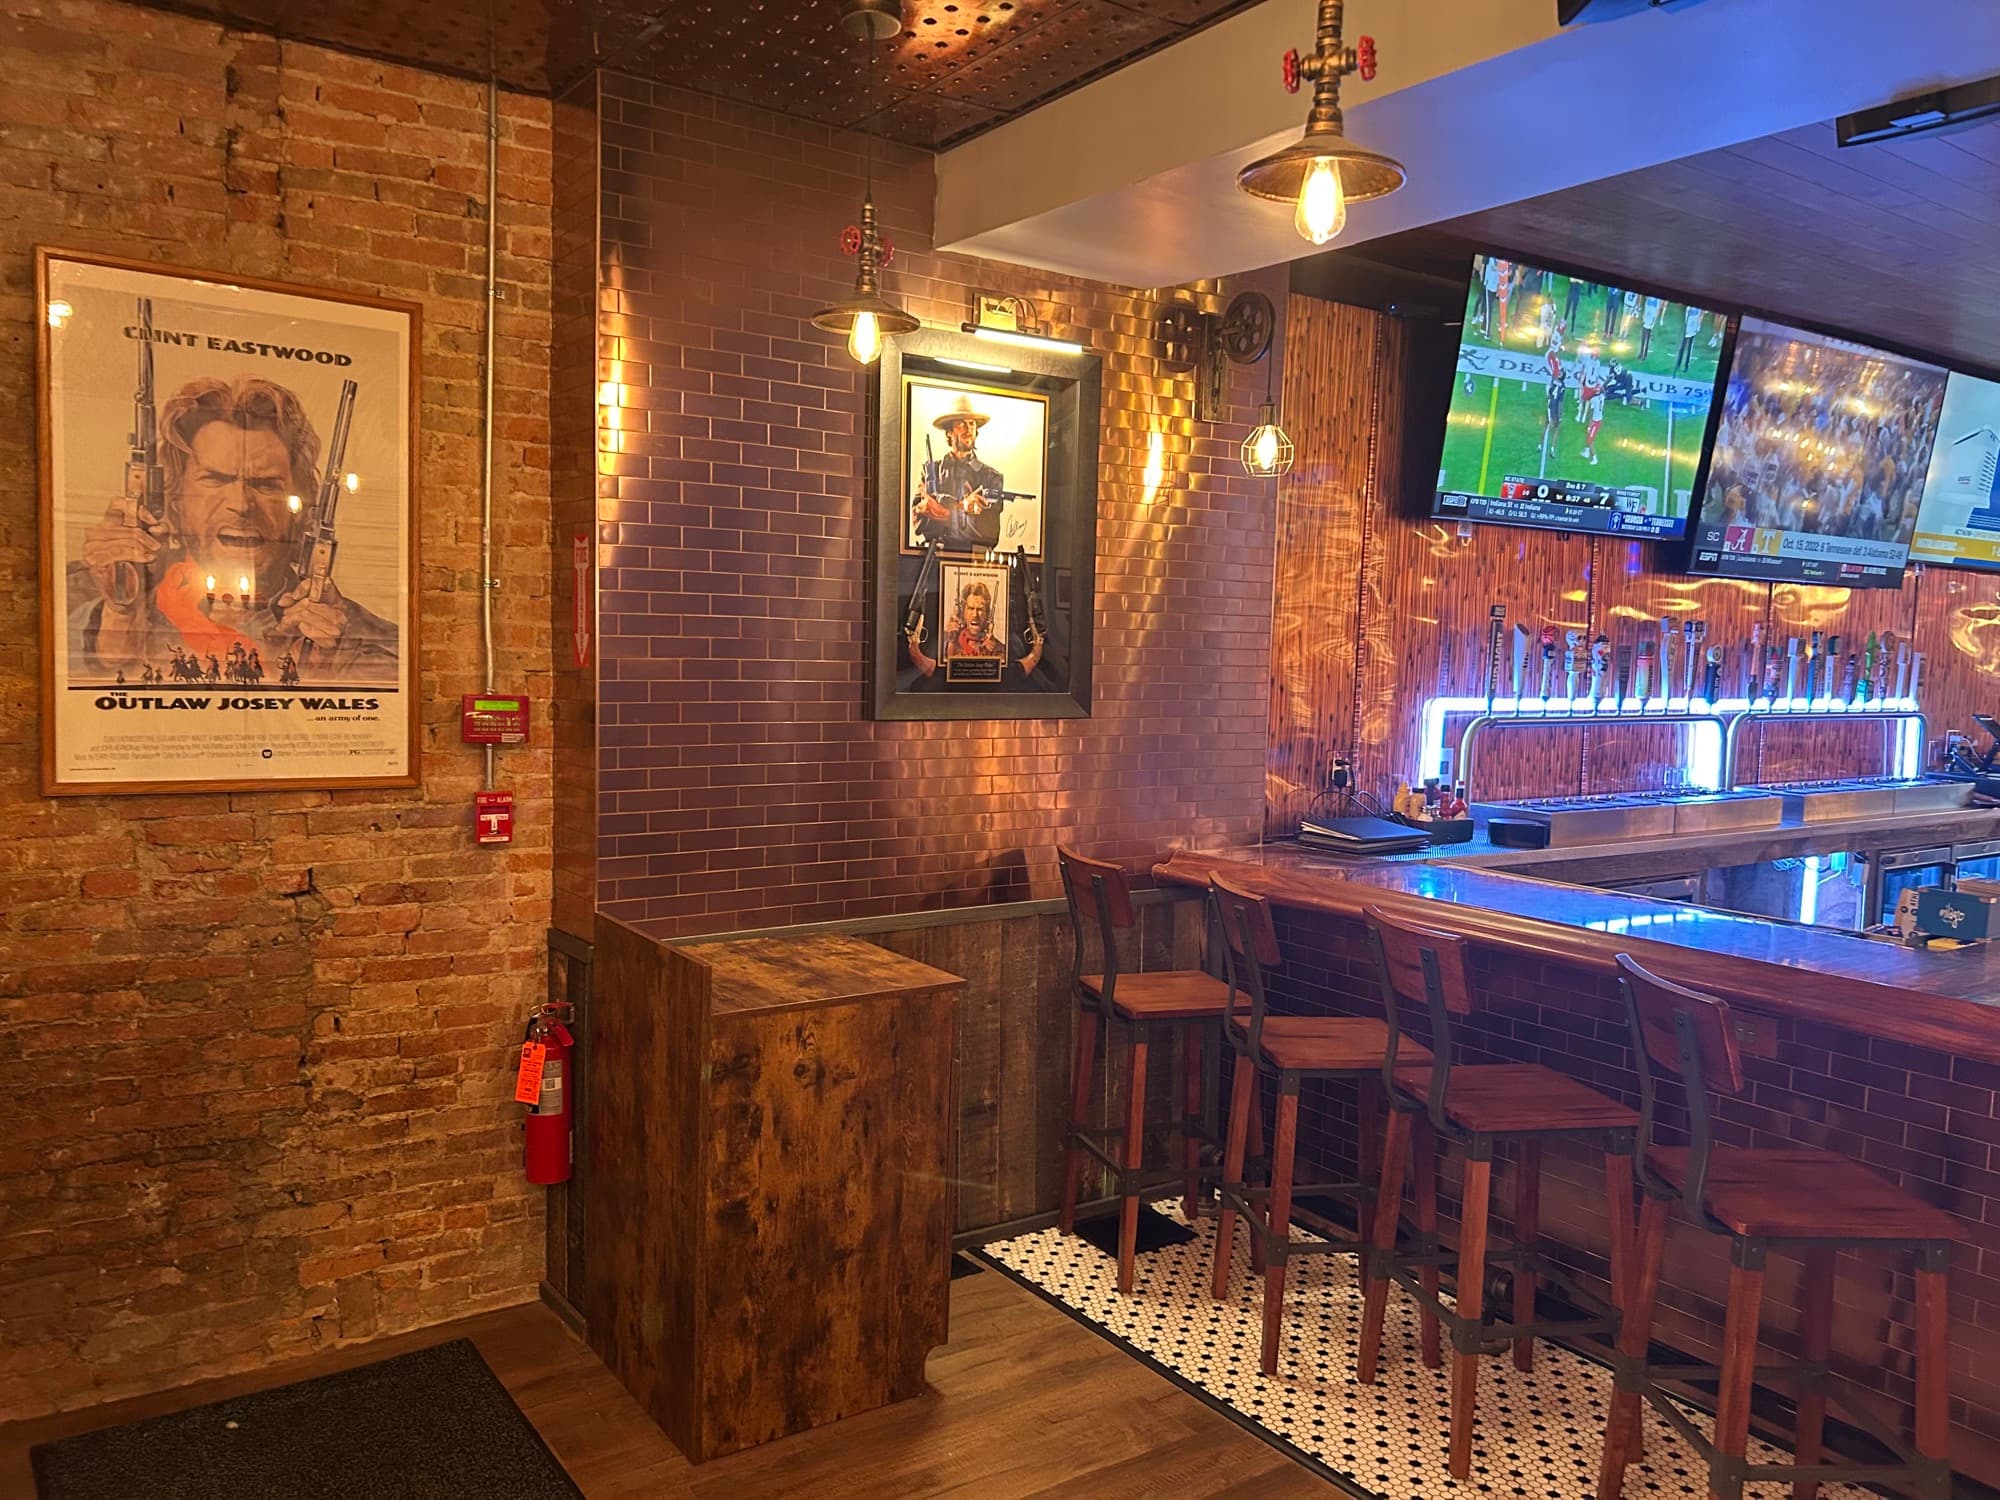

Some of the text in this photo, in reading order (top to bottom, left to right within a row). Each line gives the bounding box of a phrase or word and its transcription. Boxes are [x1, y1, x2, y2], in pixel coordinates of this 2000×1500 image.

[123, 325, 353, 368] CLINT EASTWOOD
[1537, 484, 1549, 498] 0
[1599, 492, 1610, 505] 7
[1706, 531, 1720, 542] SC
[1699, 551, 1718, 562] ESPN
[1825, 542, 1853, 555] Tennessee
[1867, 547, 1889, 559] Alabama
[95, 697, 380, 710] OUTLAW JOSEY WALES
